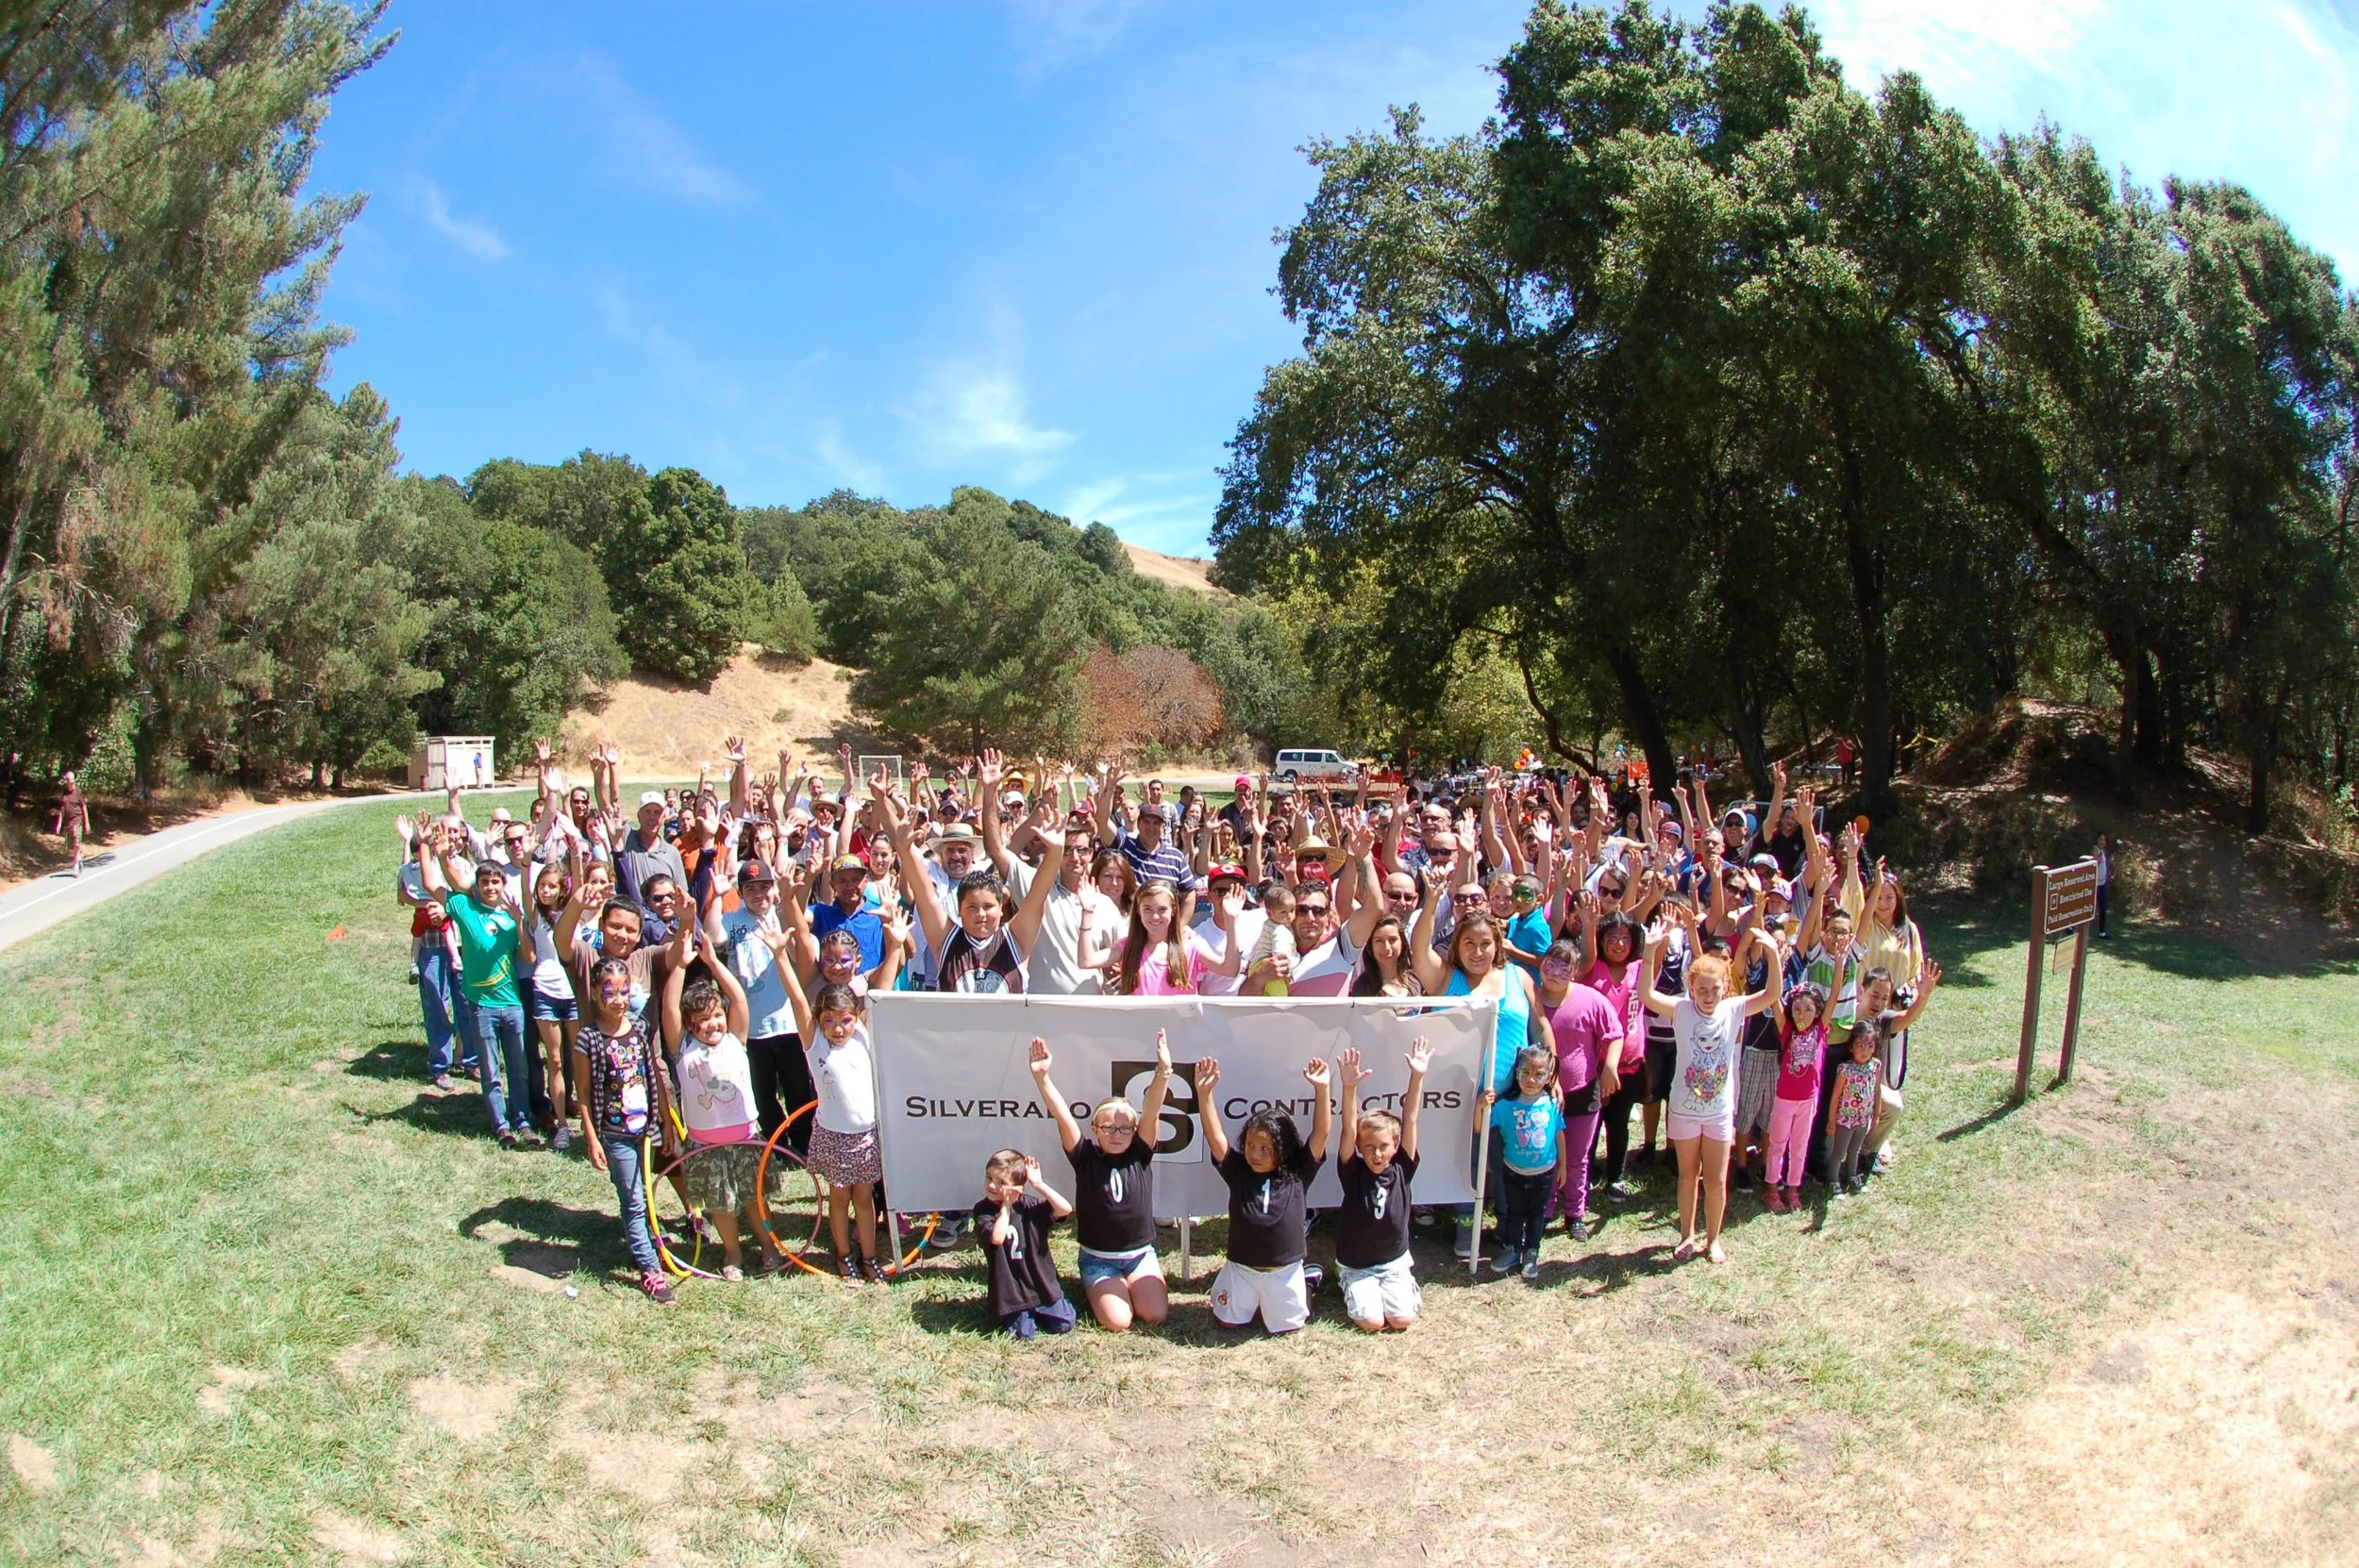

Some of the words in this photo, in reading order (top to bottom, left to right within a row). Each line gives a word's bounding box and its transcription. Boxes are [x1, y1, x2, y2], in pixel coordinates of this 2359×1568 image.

[2049, 882, 2064, 891] Large
[2065, 874, 2084, 887] Reserved
[2060, 890, 2083, 904] Restricted
[1628, 989, 1639, 1035] AERO
[906, 1095, 1092, 1120] SILVERAO
[1224, 1091, 1462, 1120] CONTCTRS
[1110, 1168, 1124, 1203] 0
[1262, 1178, 1271, 1214] 1
[1374, 1187, 1388, 1220] 3
[1006, 1225, 1023, 1259] 2
